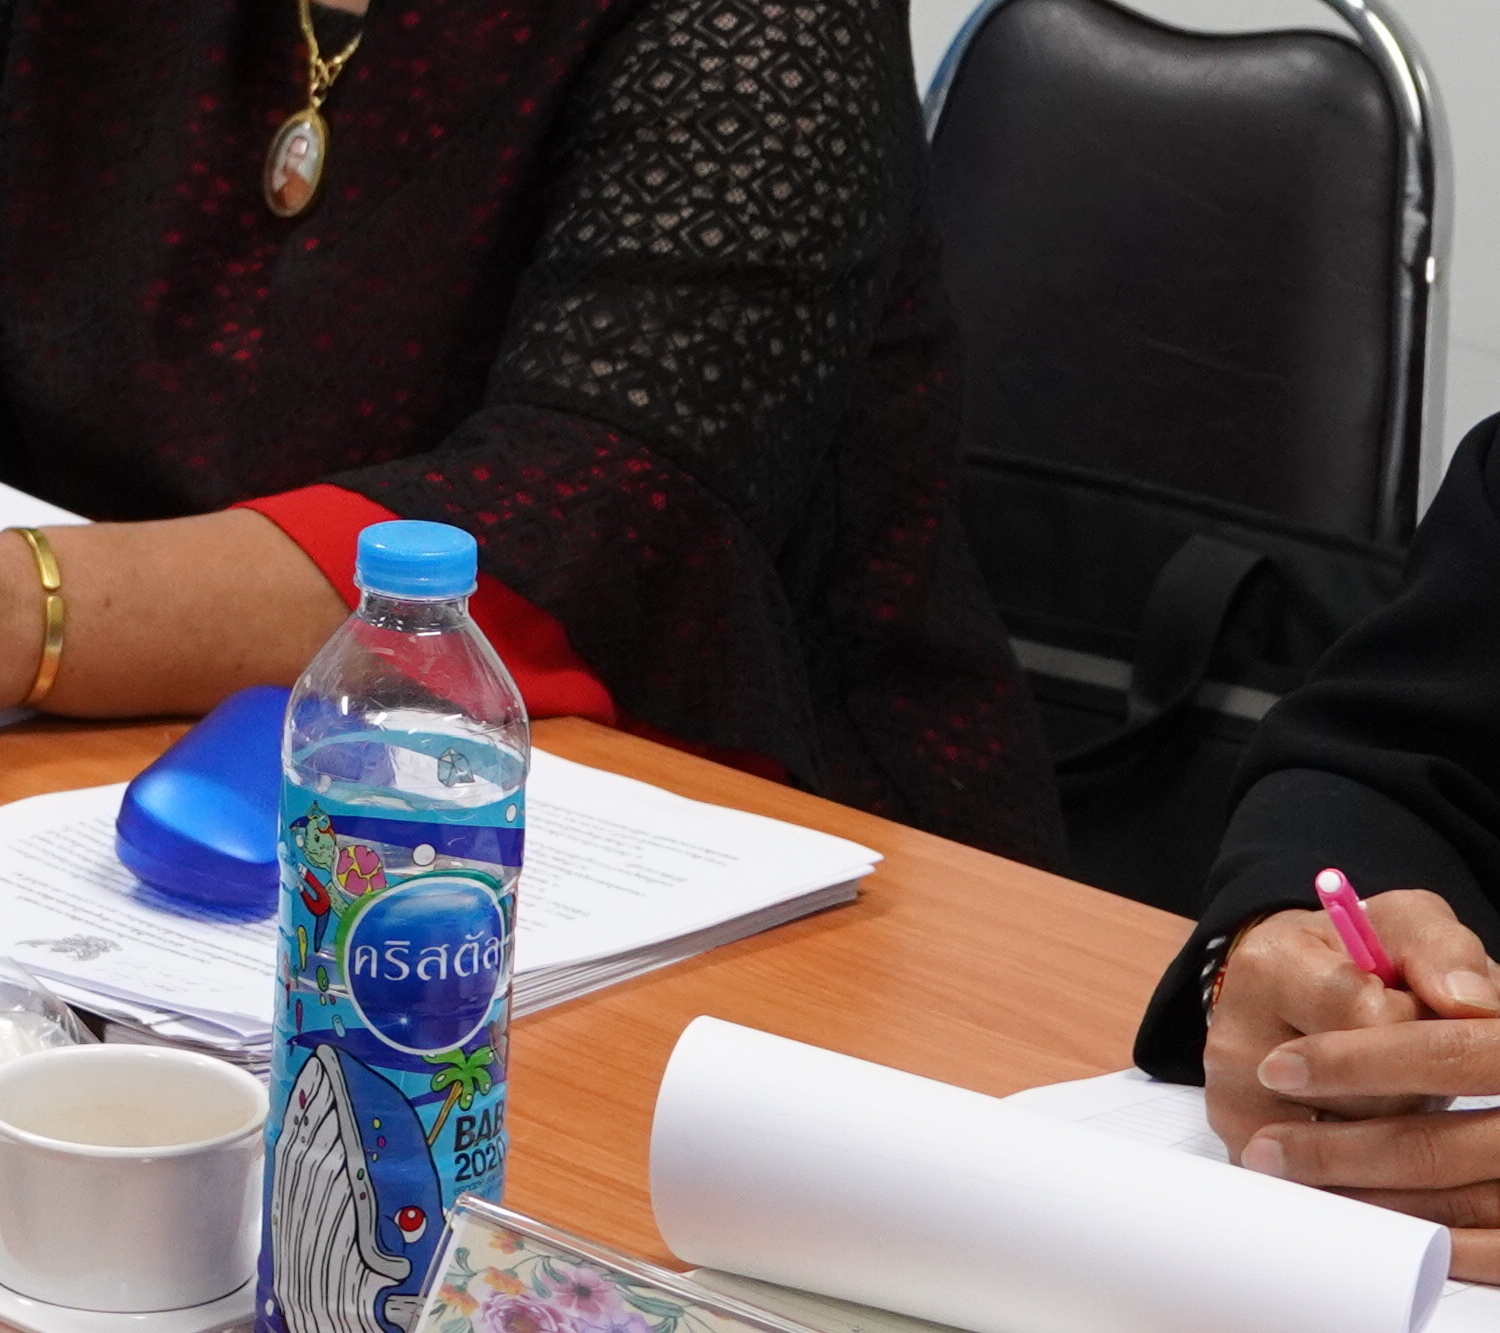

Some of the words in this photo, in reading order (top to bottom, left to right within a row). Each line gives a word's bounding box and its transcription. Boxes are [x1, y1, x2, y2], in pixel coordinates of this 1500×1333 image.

[354, 930, 500, 982] คริสตัล
[453, 1098, 505, 1153] BAB
[454, 1135, 506, 1183] 2020
